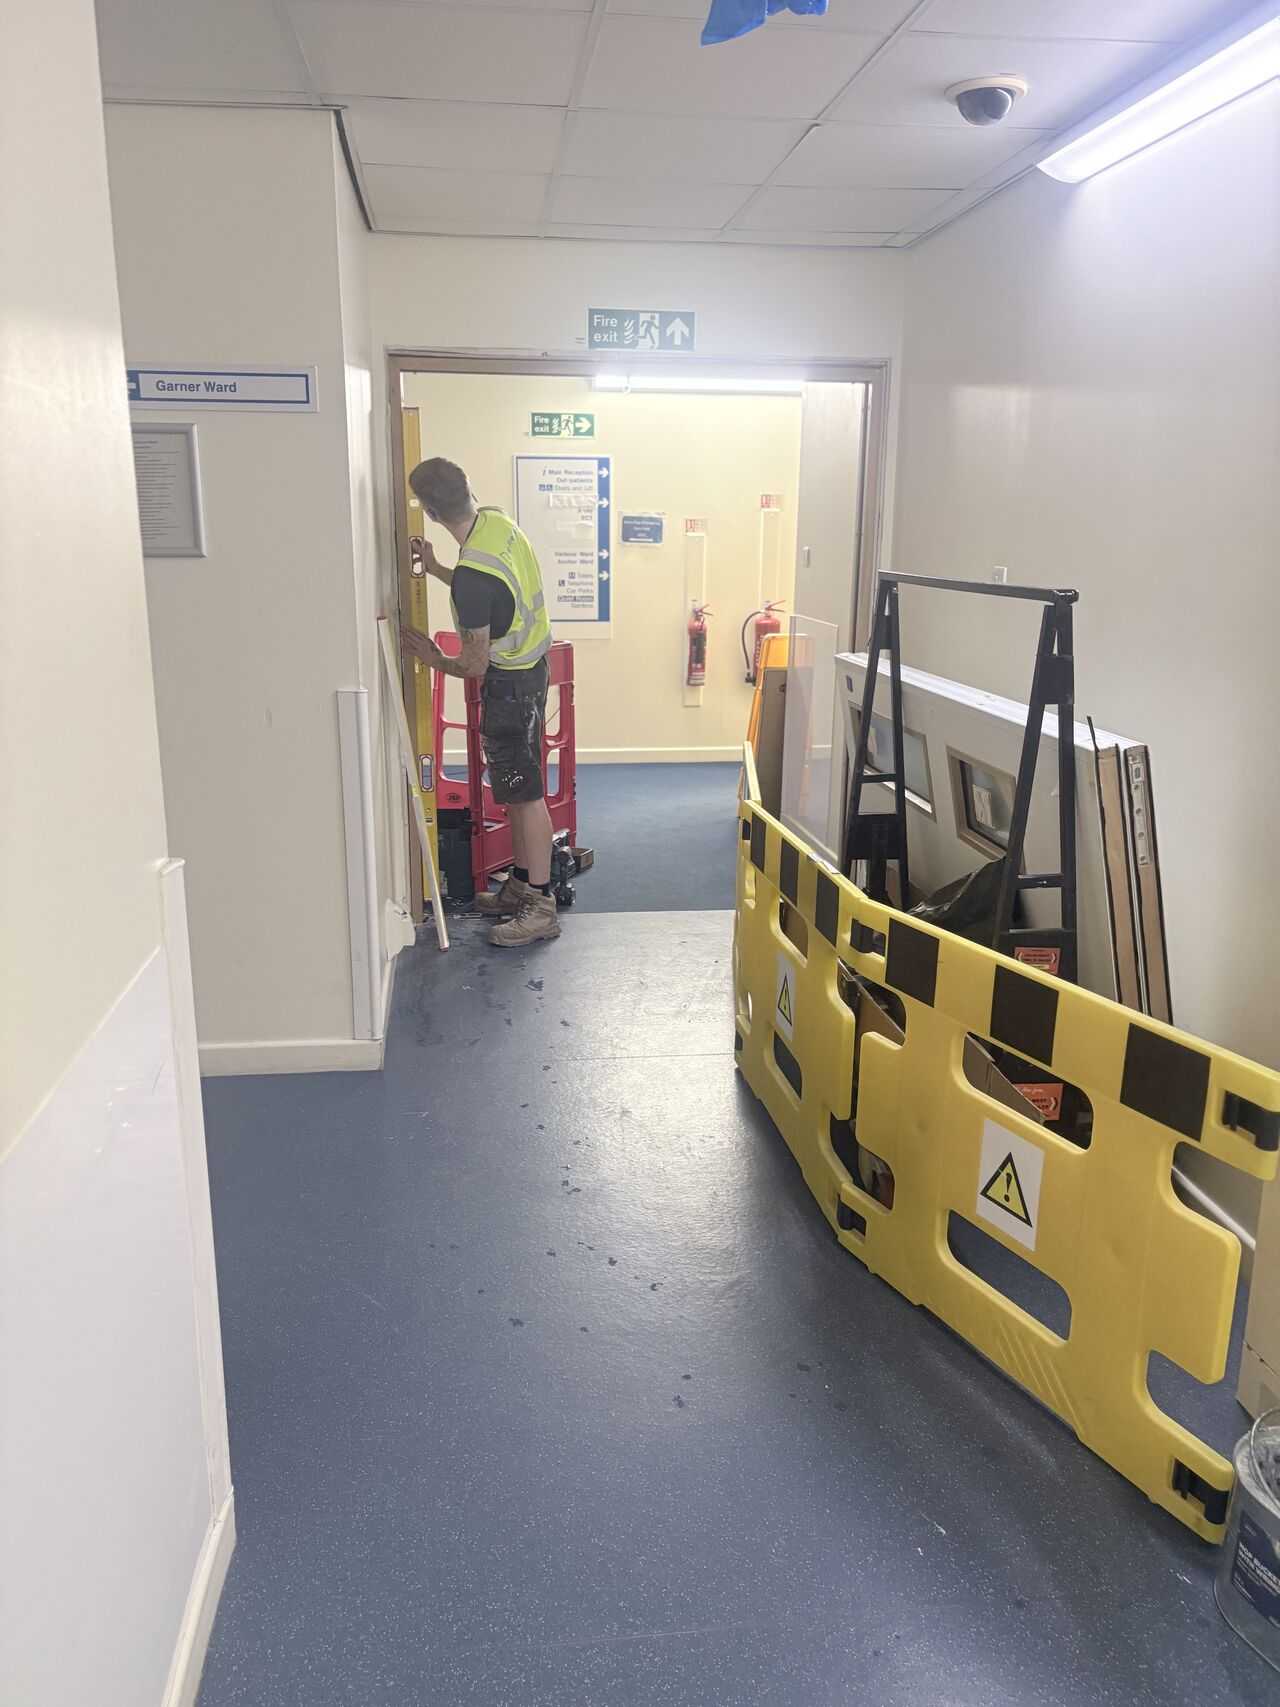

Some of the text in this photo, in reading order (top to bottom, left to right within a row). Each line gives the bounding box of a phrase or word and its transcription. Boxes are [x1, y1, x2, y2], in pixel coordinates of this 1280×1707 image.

[593, 314, 618, 327] Fire
[593, 331, 618, 343] exit
[155, 379, 237, 393] Garner Ward
[534, 415, 549, 424] Fire
[534, 424, 549, 433] exit
